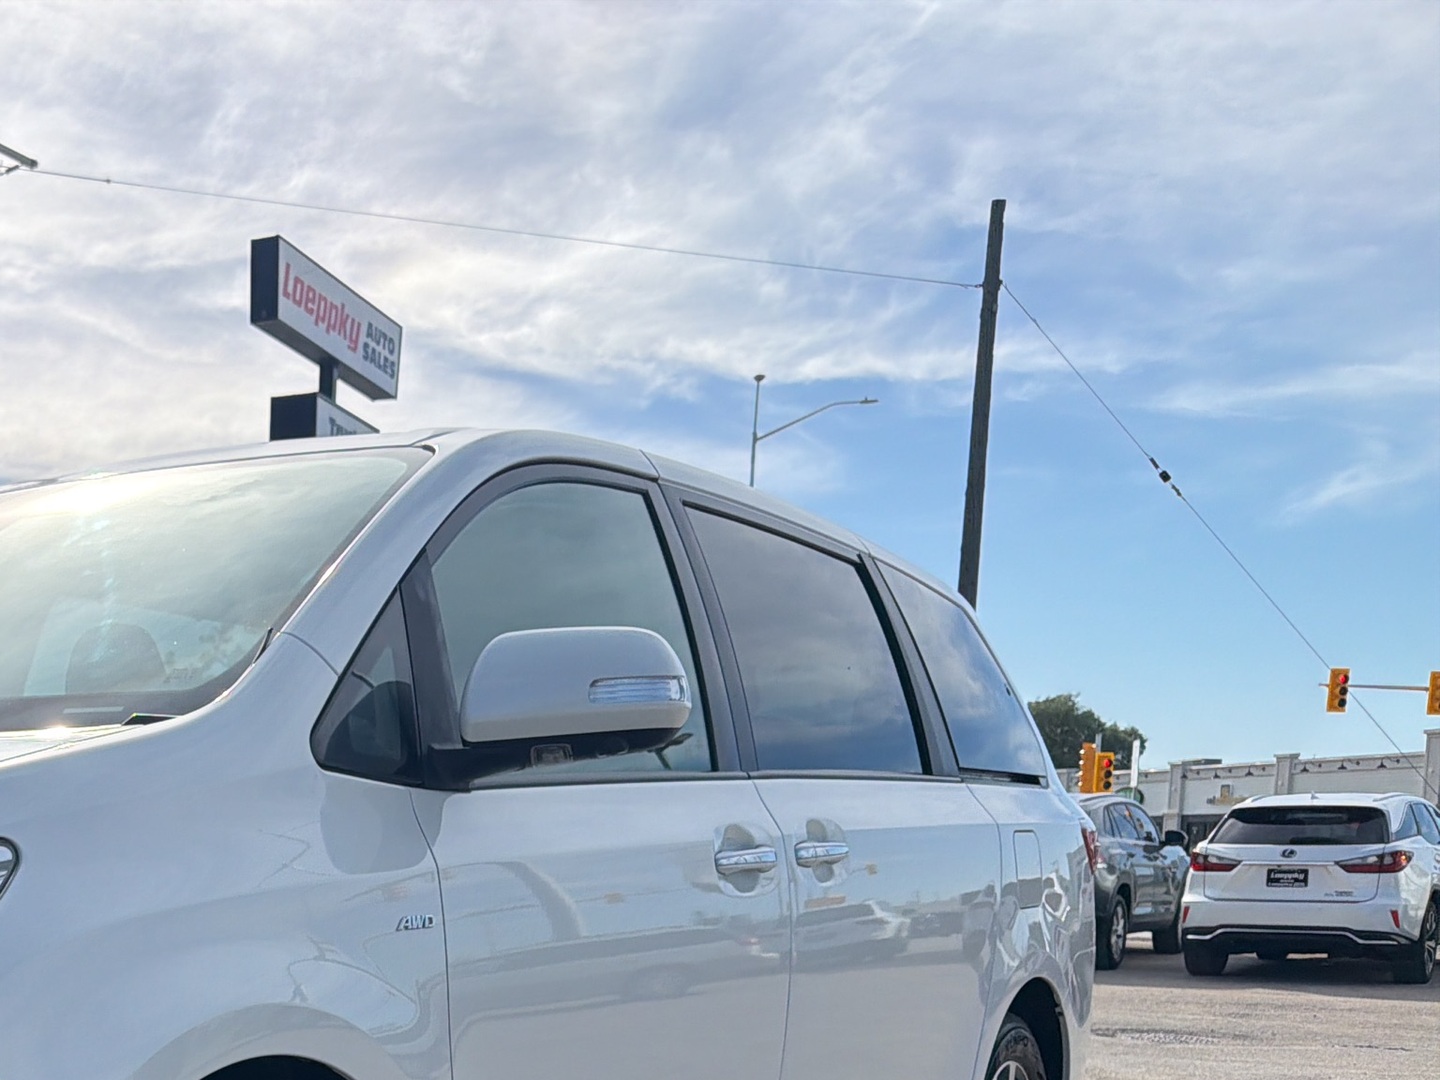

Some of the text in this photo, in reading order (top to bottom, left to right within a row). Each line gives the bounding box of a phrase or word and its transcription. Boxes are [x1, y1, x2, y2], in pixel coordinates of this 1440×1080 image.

[282, 261, 362, 353] Loeppky
[366, 321, 395, 354] AUTO
[361, 341, 396, 379] SALES
[396, 914, 435, 931] AWD
